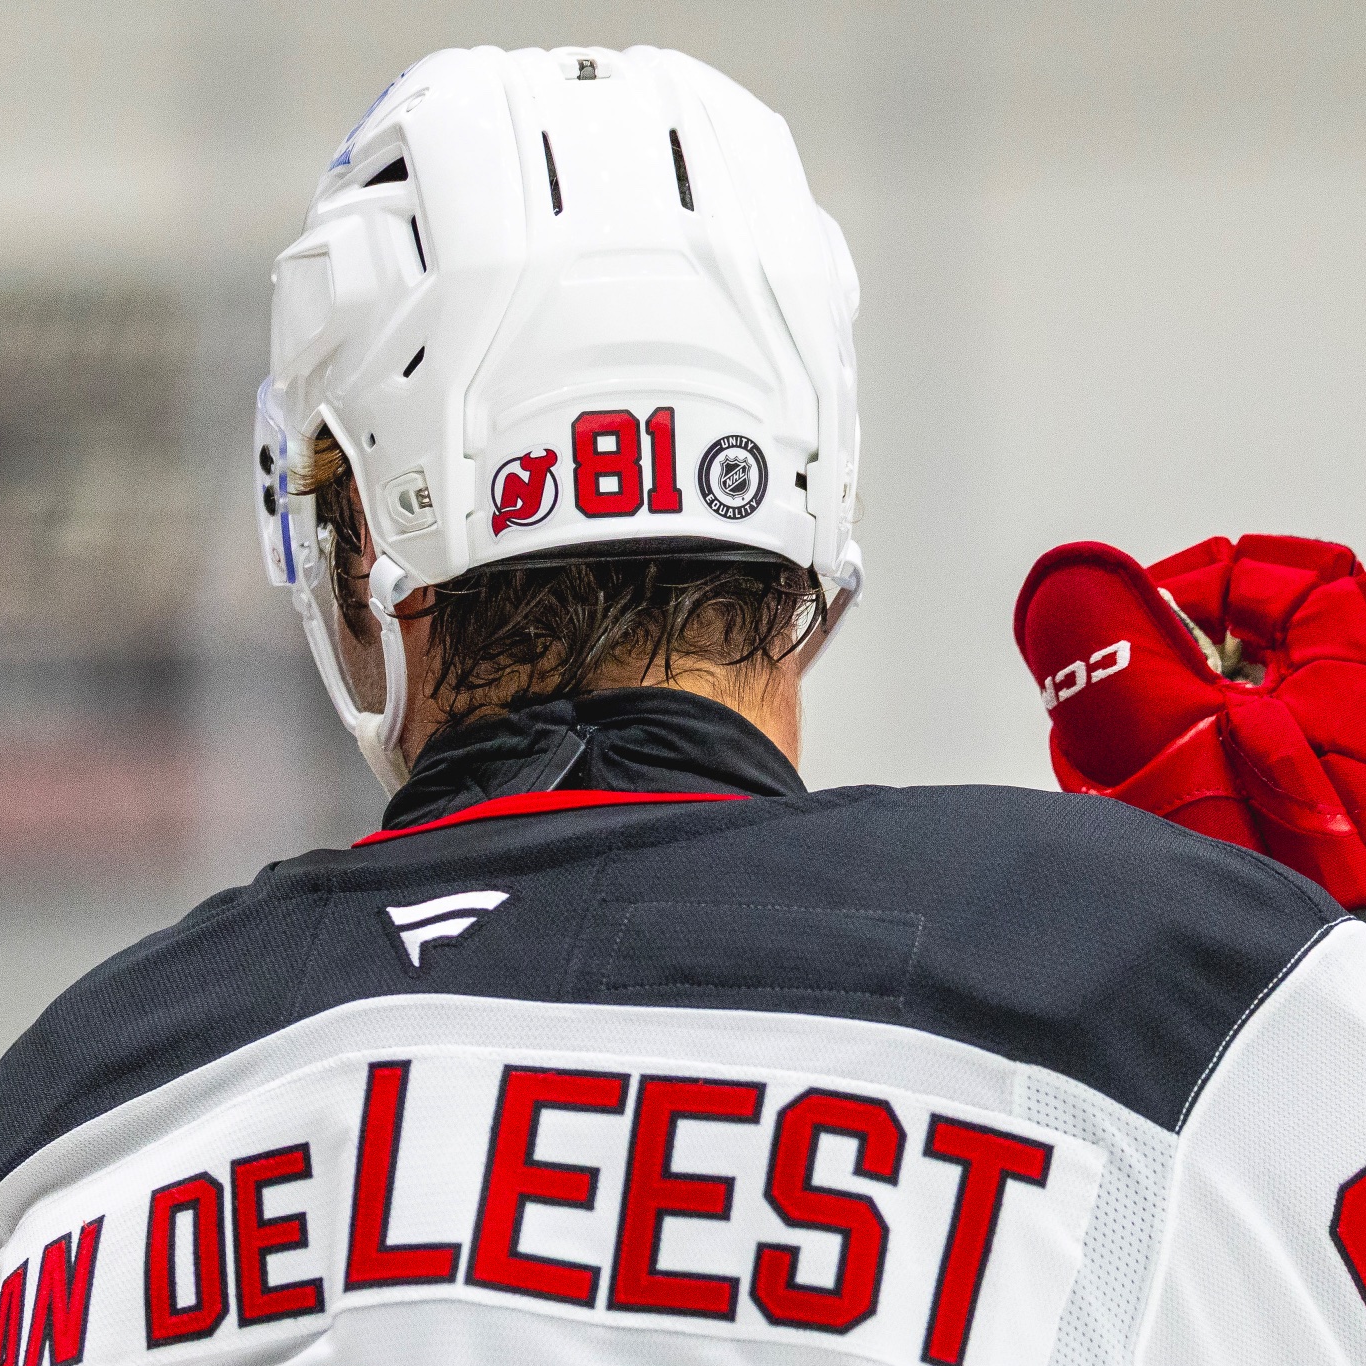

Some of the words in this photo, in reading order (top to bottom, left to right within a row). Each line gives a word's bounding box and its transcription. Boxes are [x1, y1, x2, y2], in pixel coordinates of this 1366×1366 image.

[721, 436, 754, 450] UNITY
[571, 407, 683, 518] 81
[726, 469, 745, 488] NHL
[706, 493, 757, 518] EQUALITY
[143, 1141, 326, 1350] DE
